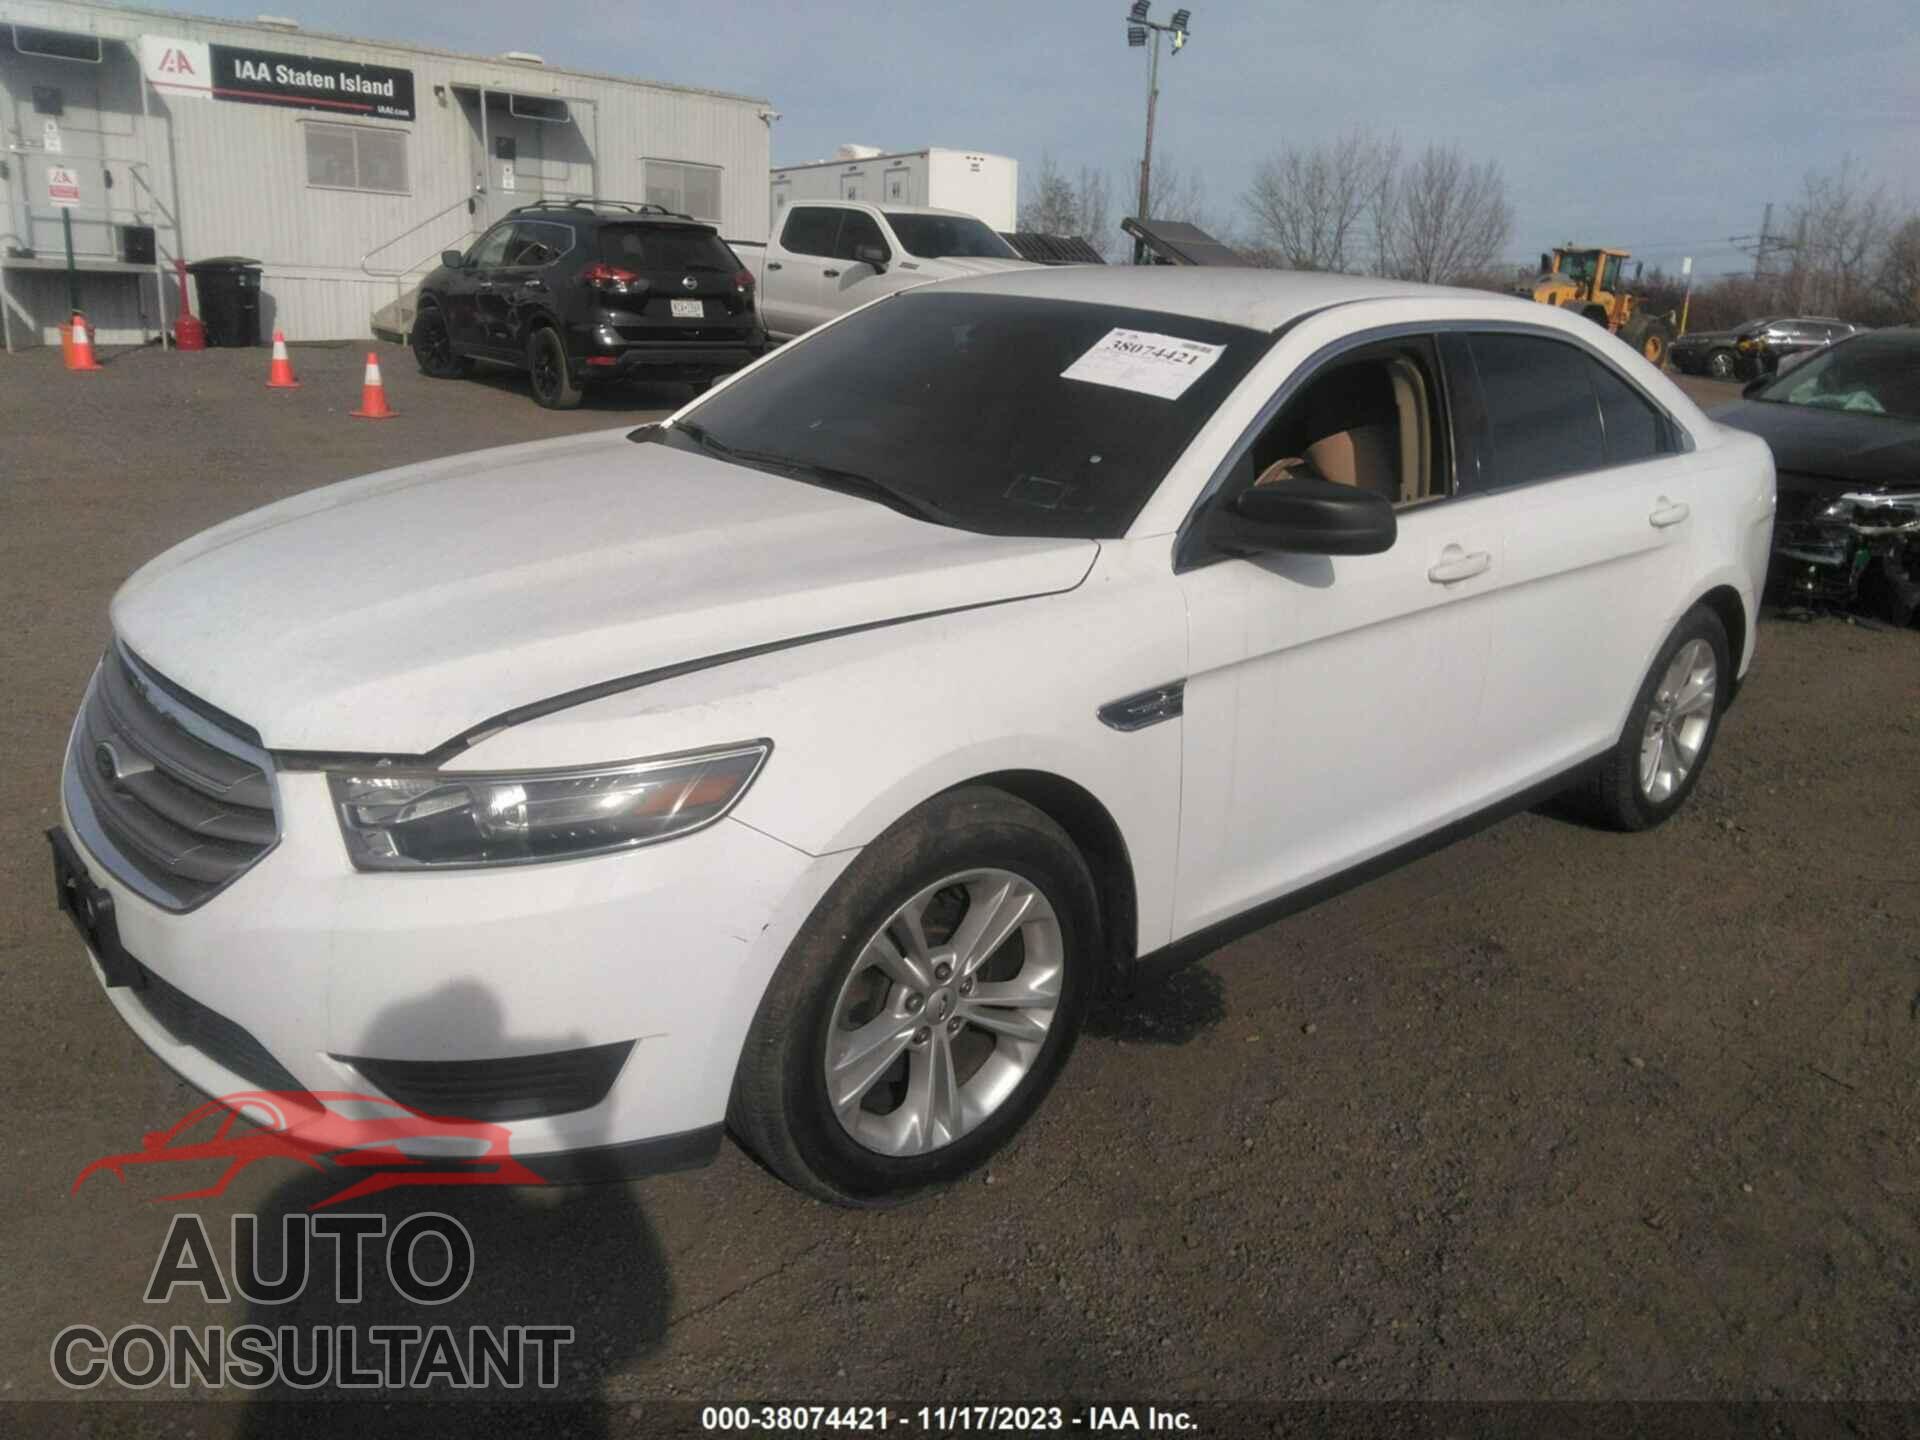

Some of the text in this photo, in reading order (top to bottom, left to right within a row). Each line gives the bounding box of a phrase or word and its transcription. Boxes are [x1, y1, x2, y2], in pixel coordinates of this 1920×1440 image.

[234, 59, 394, 96] IAA Staten Island
